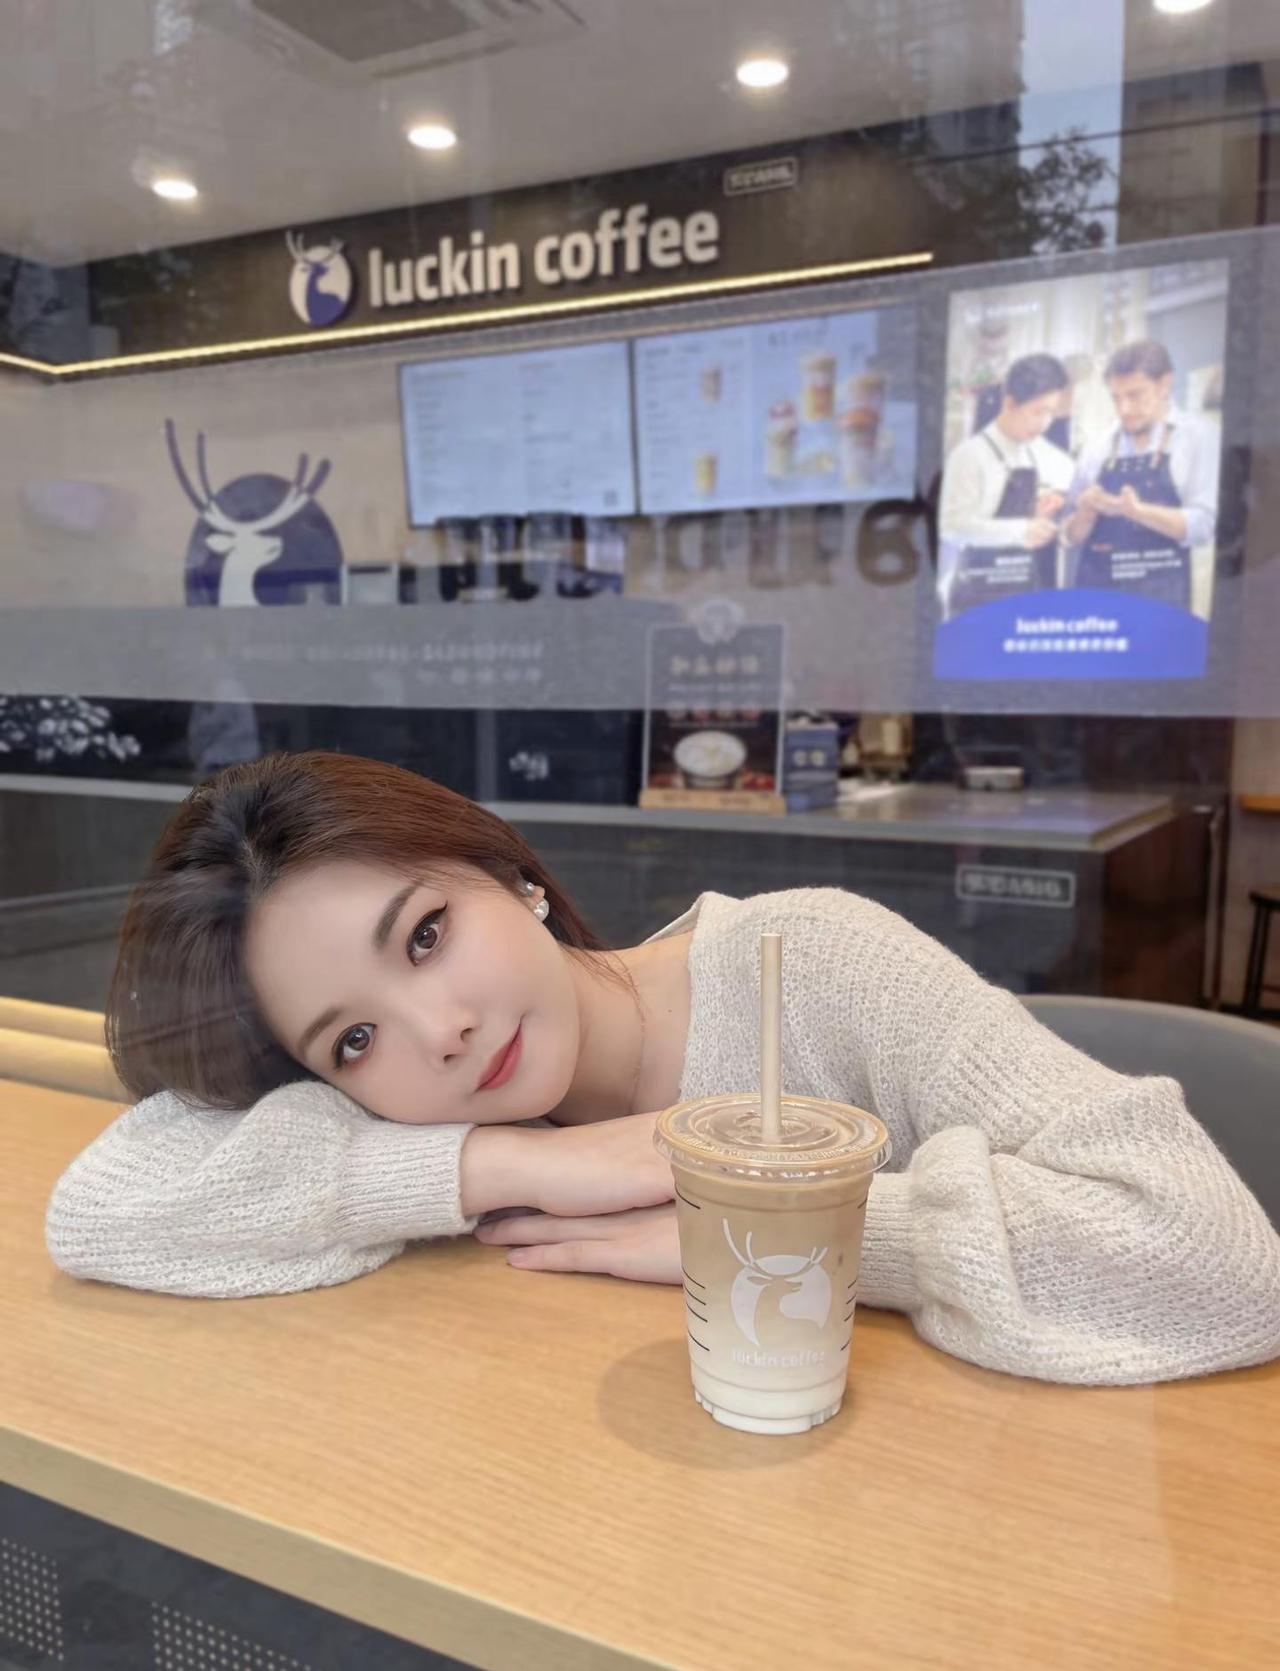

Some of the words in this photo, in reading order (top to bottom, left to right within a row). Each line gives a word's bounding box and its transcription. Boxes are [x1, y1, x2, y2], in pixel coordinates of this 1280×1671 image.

[368, 229, 520, 308] luckin
[533, 203, 720, 285] coffee
[1066, 616, 1118, 633] coffee
